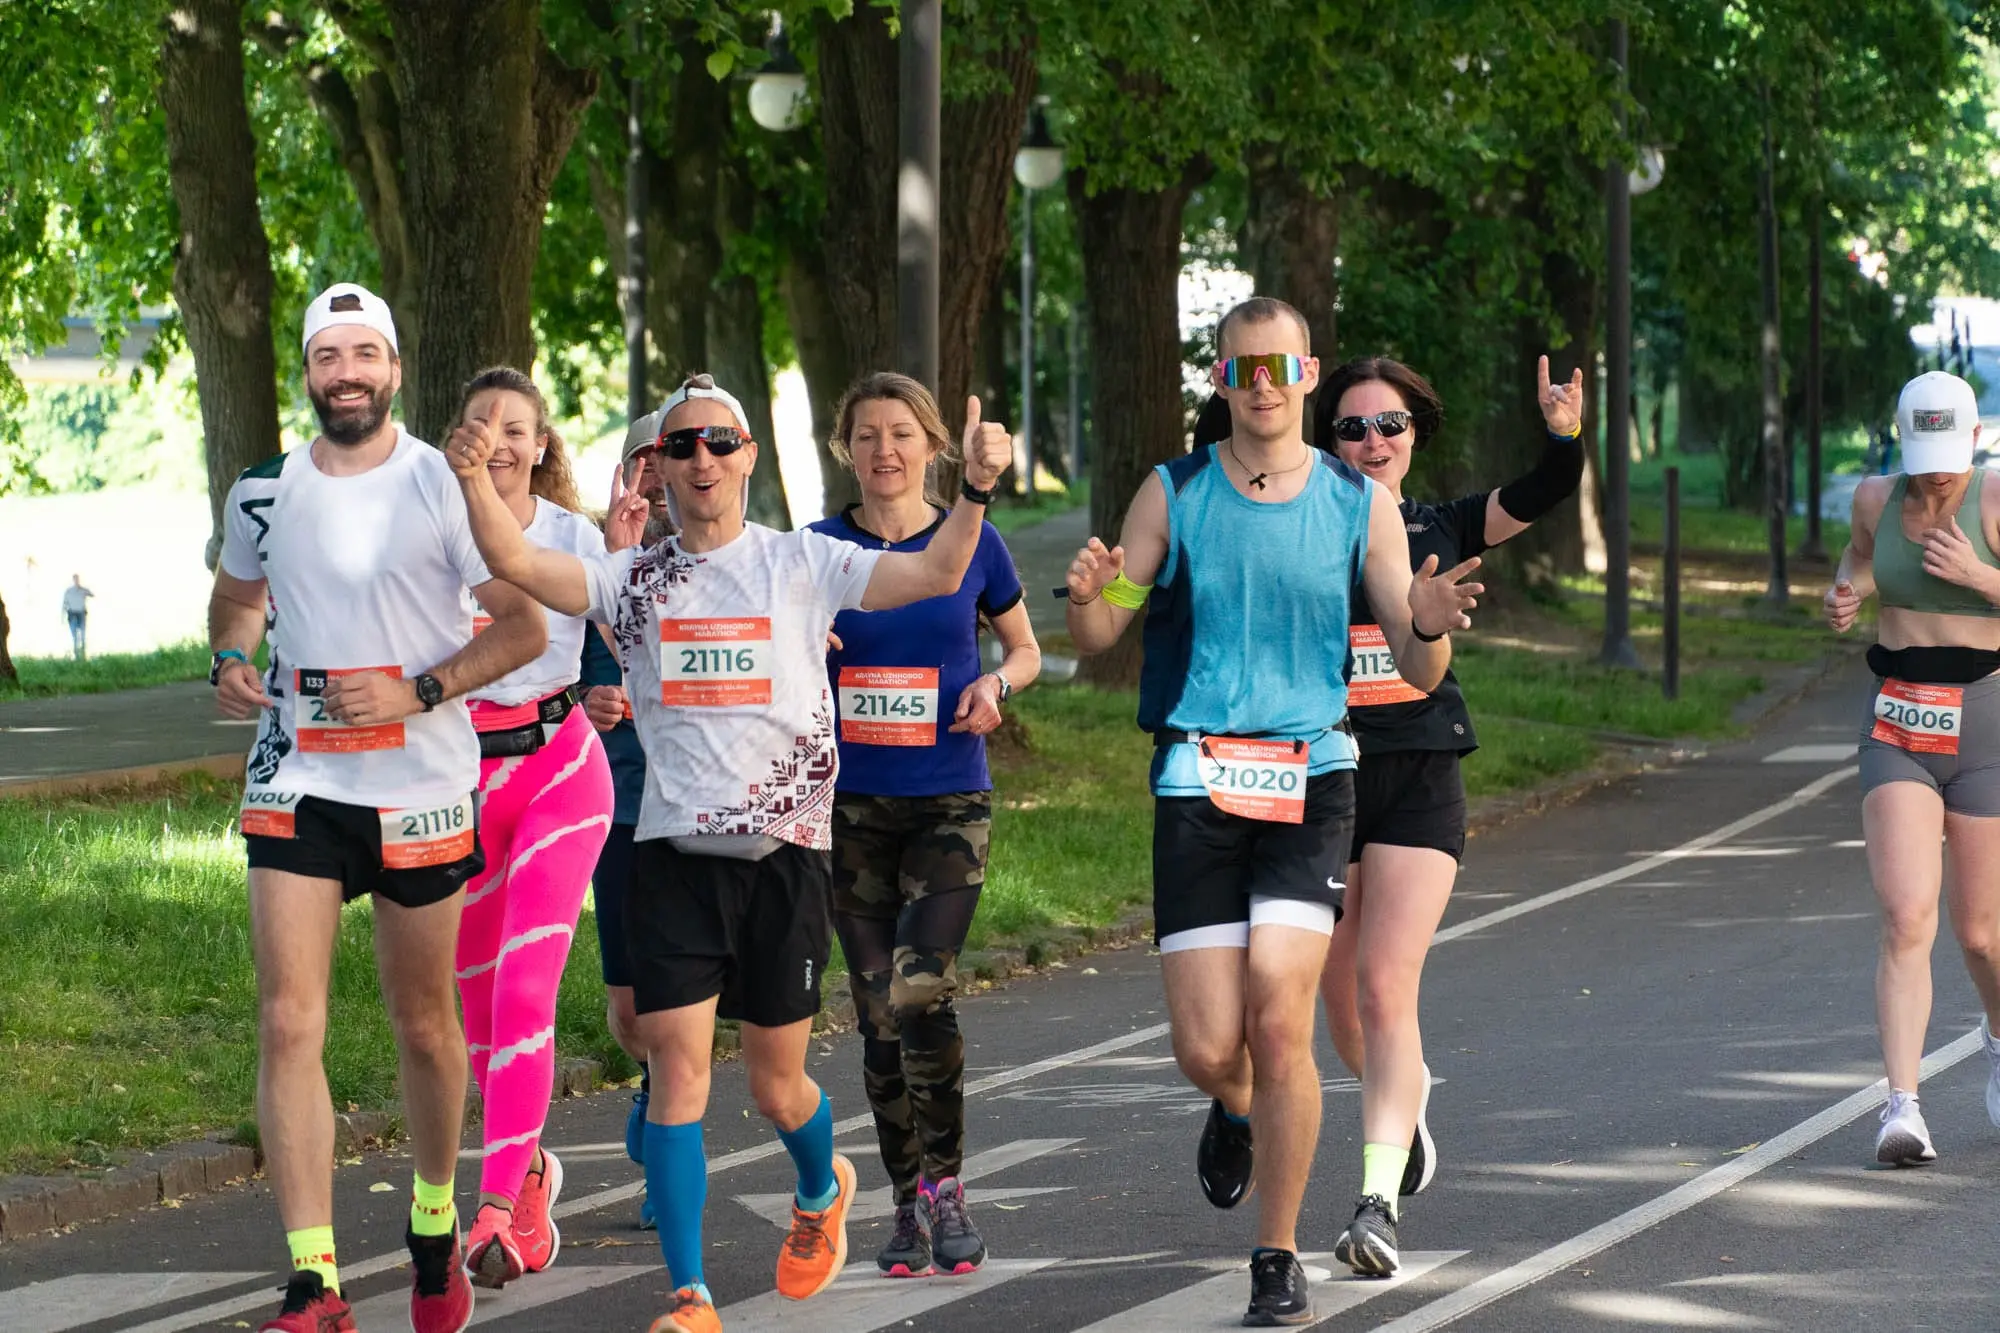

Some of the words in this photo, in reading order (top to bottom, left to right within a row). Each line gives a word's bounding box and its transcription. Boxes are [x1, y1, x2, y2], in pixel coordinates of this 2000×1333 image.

[680, 648, 755, 673] 21116
[305, 677, 325, 689] 133
[853, 694, 926, 717] 21145
[1883, 701, 1955, 731] 21006
[1208, 766, 1298, 792] 21020
[401, 804, 464, 837] 21118
